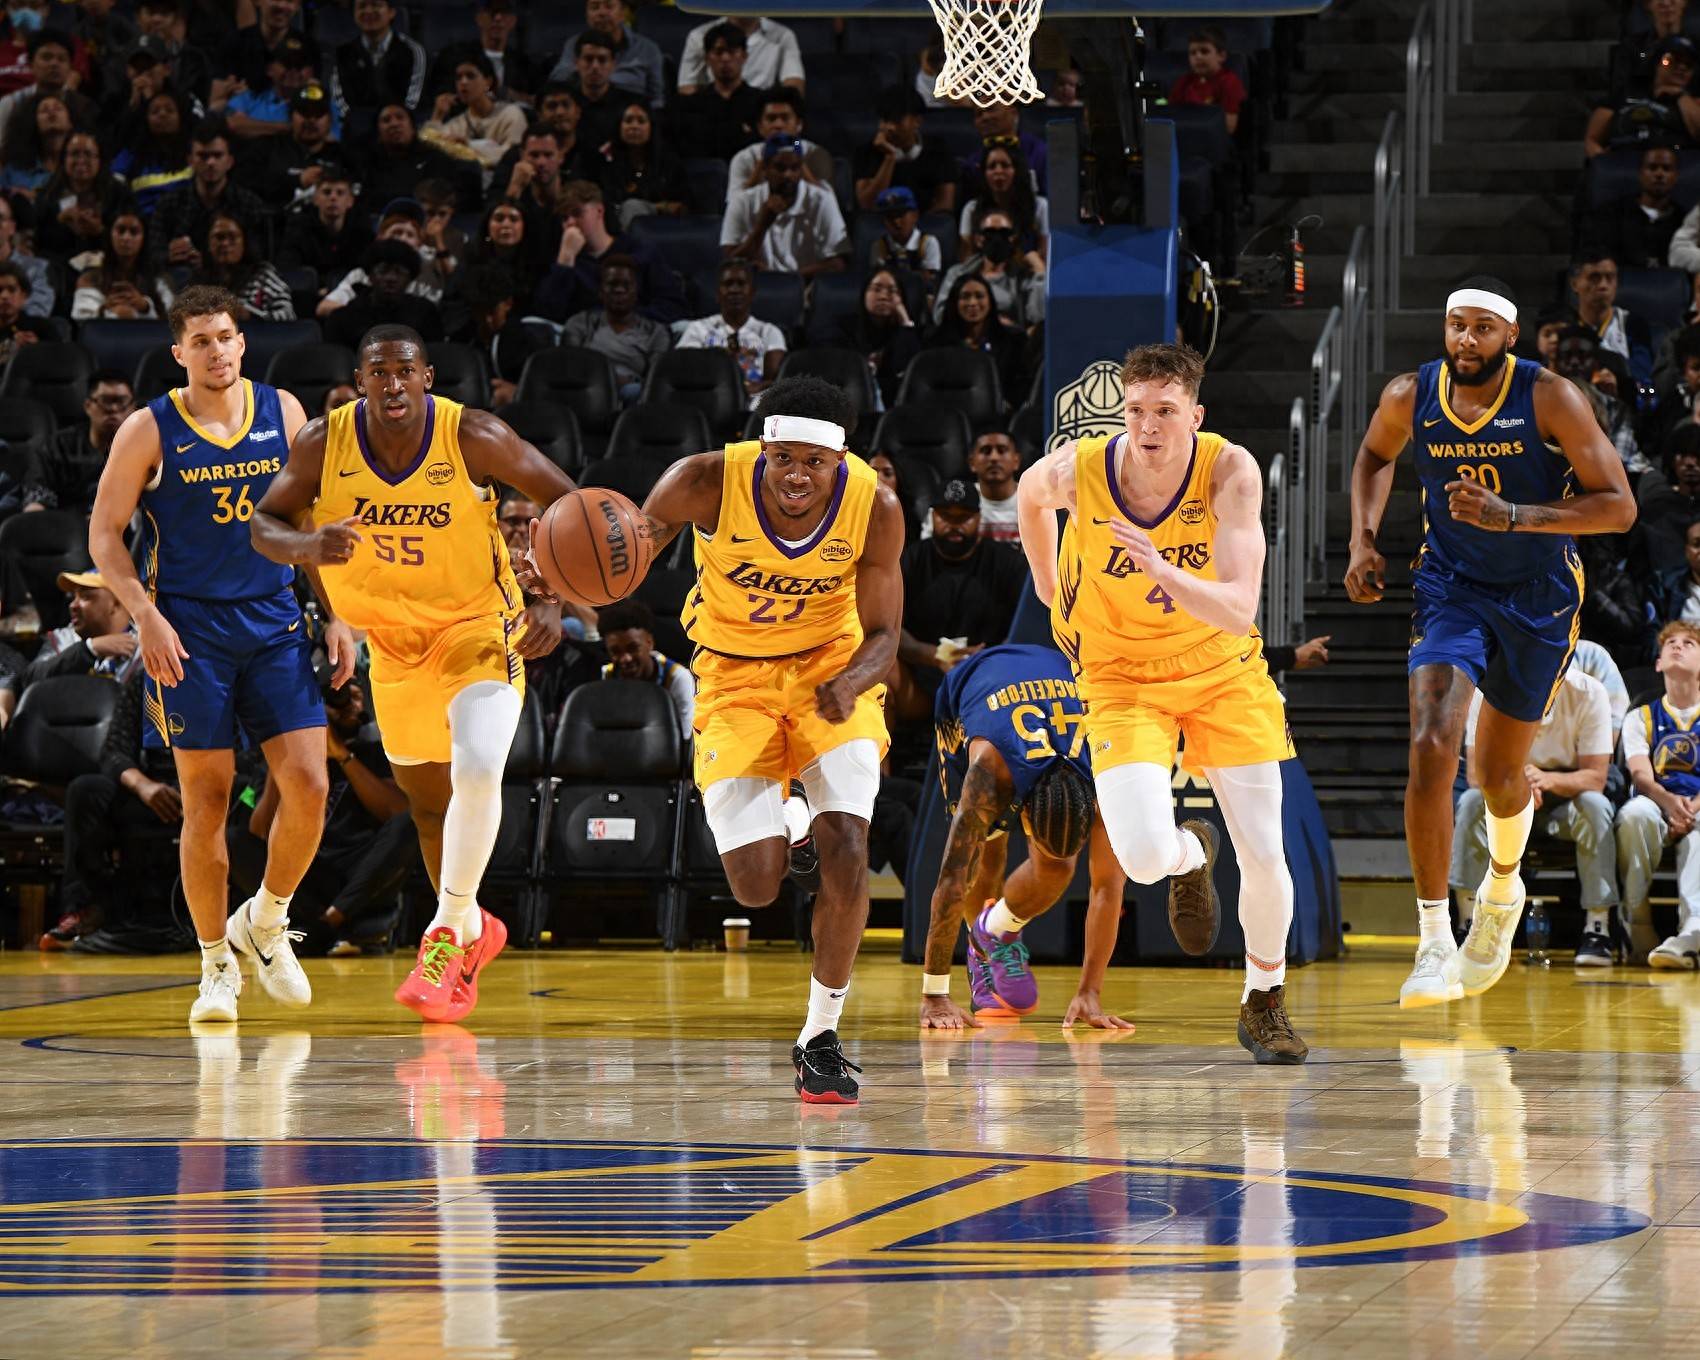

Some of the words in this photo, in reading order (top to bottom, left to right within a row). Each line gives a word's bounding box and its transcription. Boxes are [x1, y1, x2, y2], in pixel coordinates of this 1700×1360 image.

[248, 429, 279, 442] Rakuten
[1493, 418, 1525, 429] Rakuten
[1426, 440, 1525, 458] WARRIORS
[179, 457, 281, 484] WARRIORS
[428, 468, 453, 478] bibigo
[211, 484, 255, 525] 36
[353, 497, 452, 529] LAKERS
[1181, 506, 1203, 517] bibigo
[372, 534, 425, 566] 55
[598, 499, 629, 578] Wilson
[822, 545, 851, 556] bibigo
[1101, 542, 1211, 579] LAERS
[1145, 583, 1177, 615] 4
[986, 679, 1078, 711] ACKELFORD
[1011, 701, 1087, 760] 45
